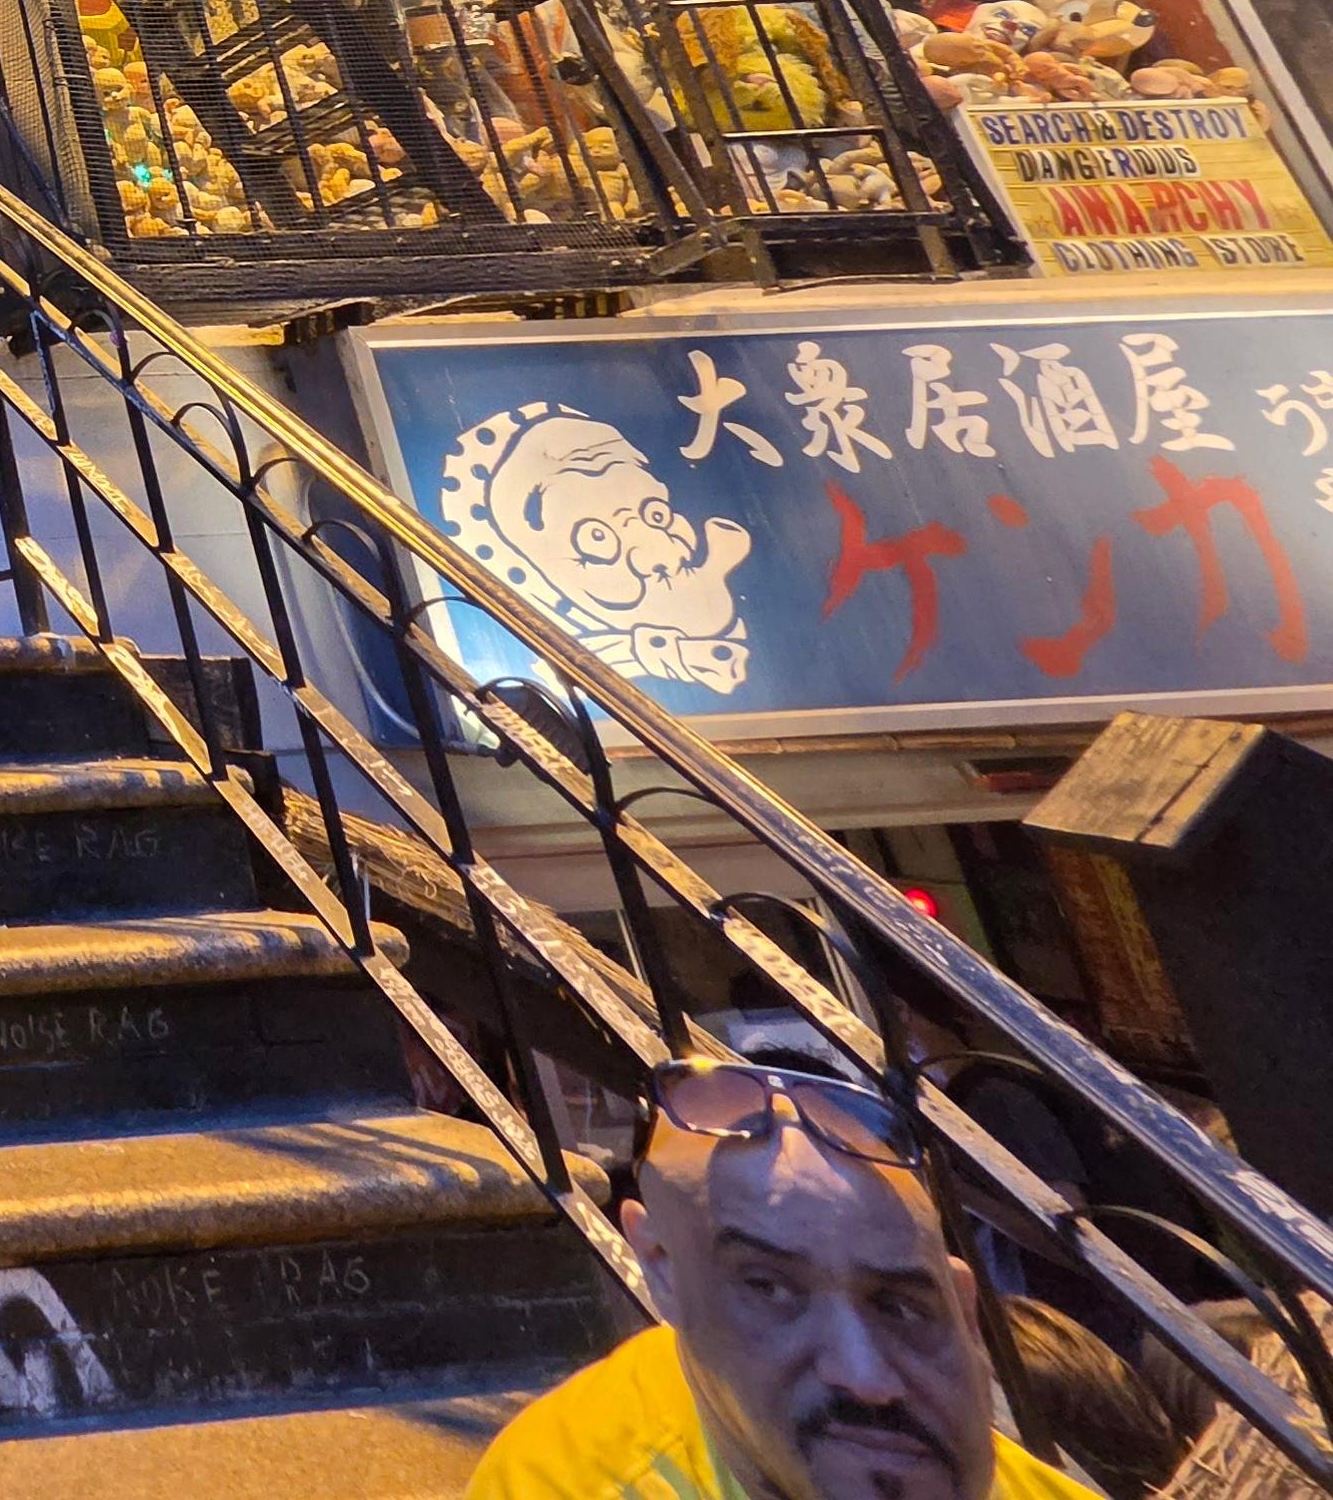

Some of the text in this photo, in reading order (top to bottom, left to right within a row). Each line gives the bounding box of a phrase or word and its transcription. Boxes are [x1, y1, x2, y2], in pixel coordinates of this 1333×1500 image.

[1048, 179, 1272, 238] ANARCHY
[1052, 234, 1306, 273] CLOTHING STORE
[678, 331, 1237, 474] 大衆居酒屋
[822, 453, 1309, 685] ケンカ
